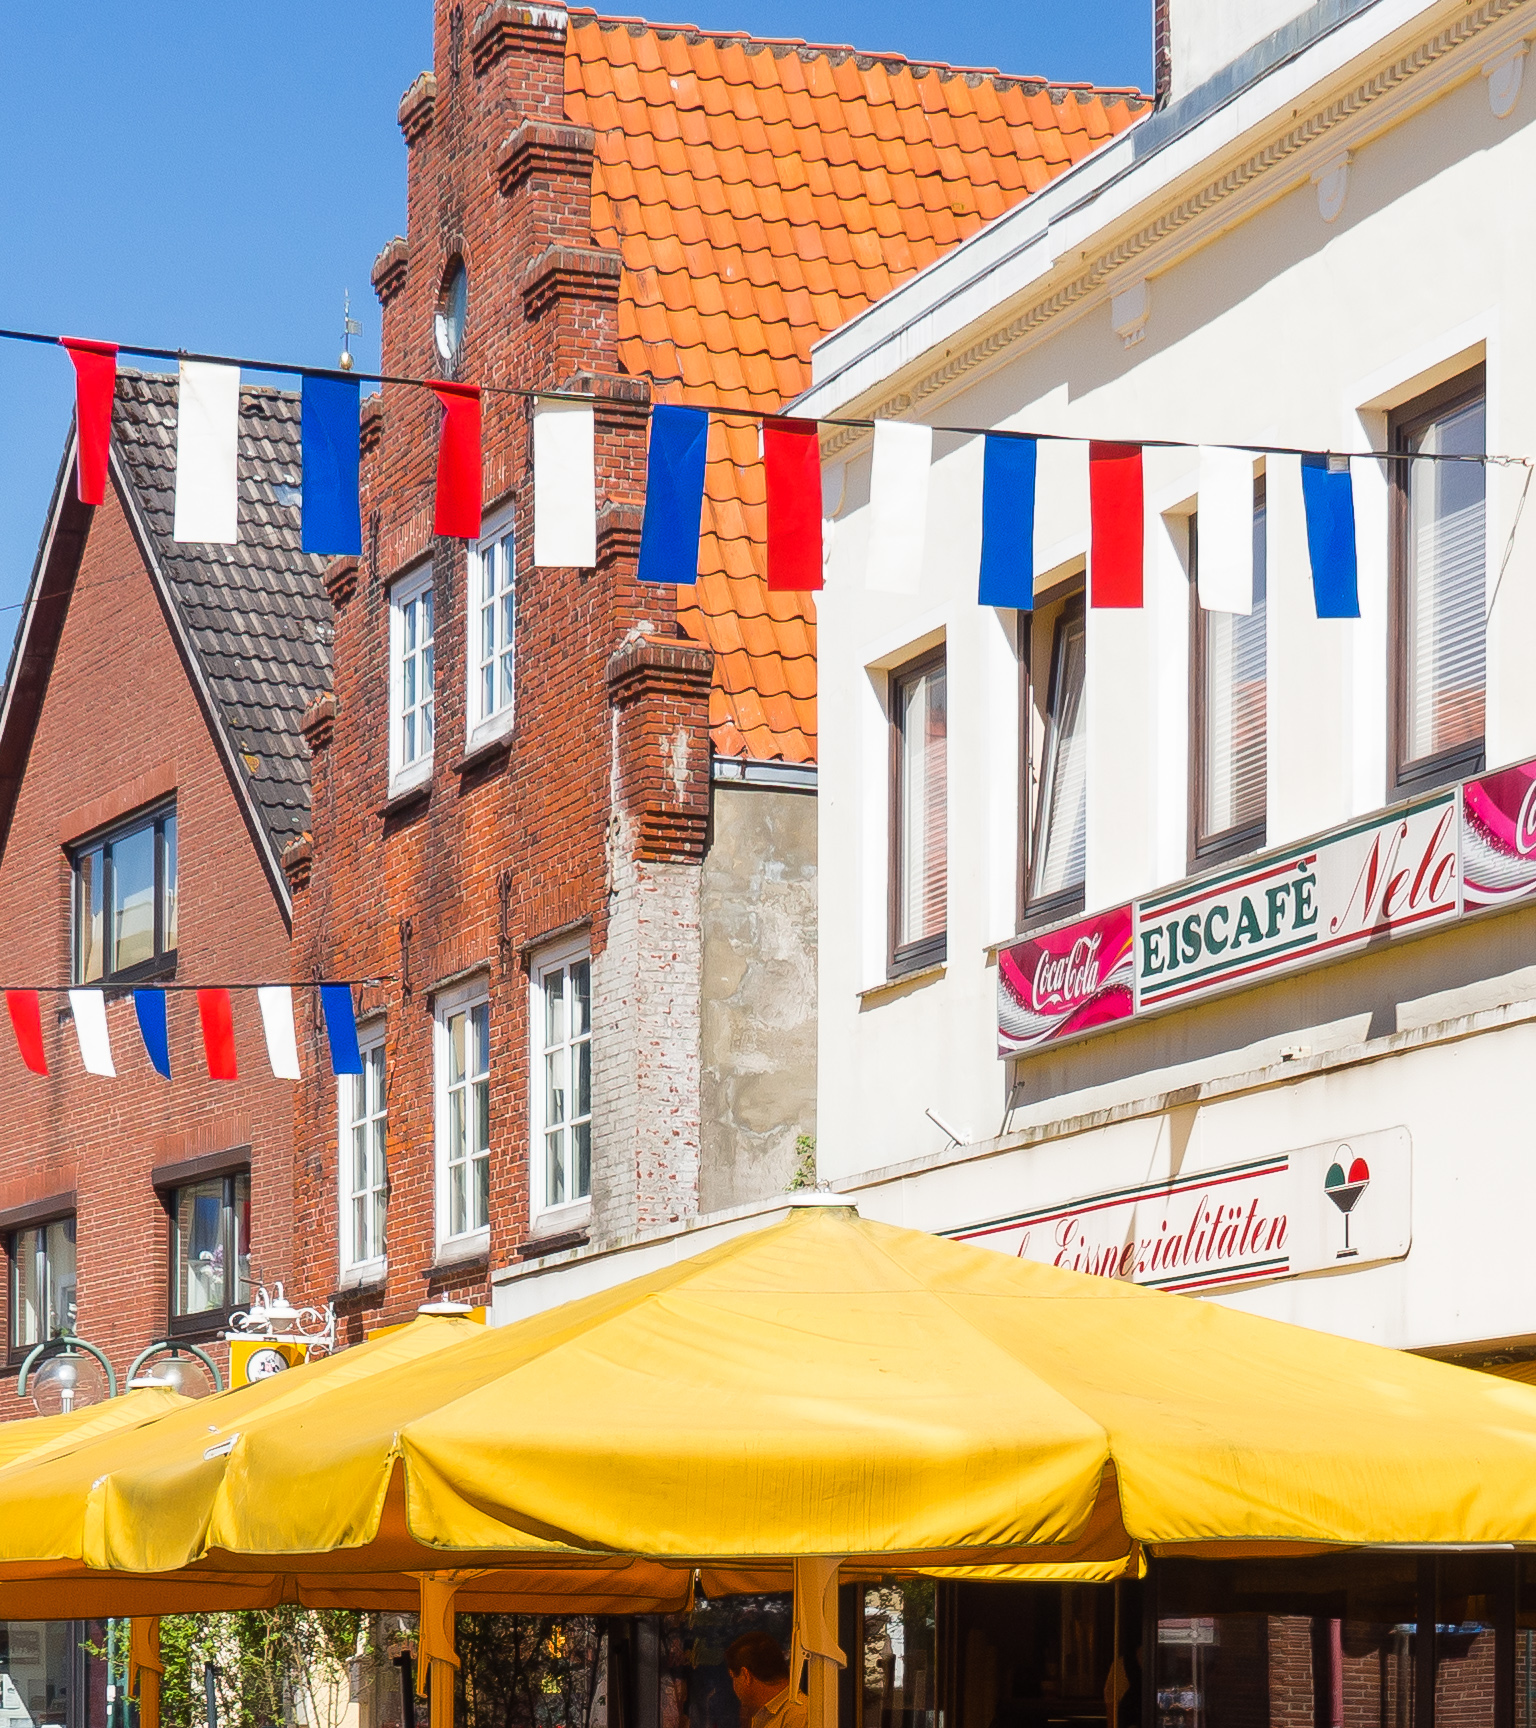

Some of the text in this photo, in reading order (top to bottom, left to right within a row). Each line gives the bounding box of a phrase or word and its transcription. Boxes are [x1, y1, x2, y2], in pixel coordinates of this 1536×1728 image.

[1140, 805, 1456, 978] EISCAFÈ Nelo
[1032, 932, 1102, 1010] Coca-Cola
